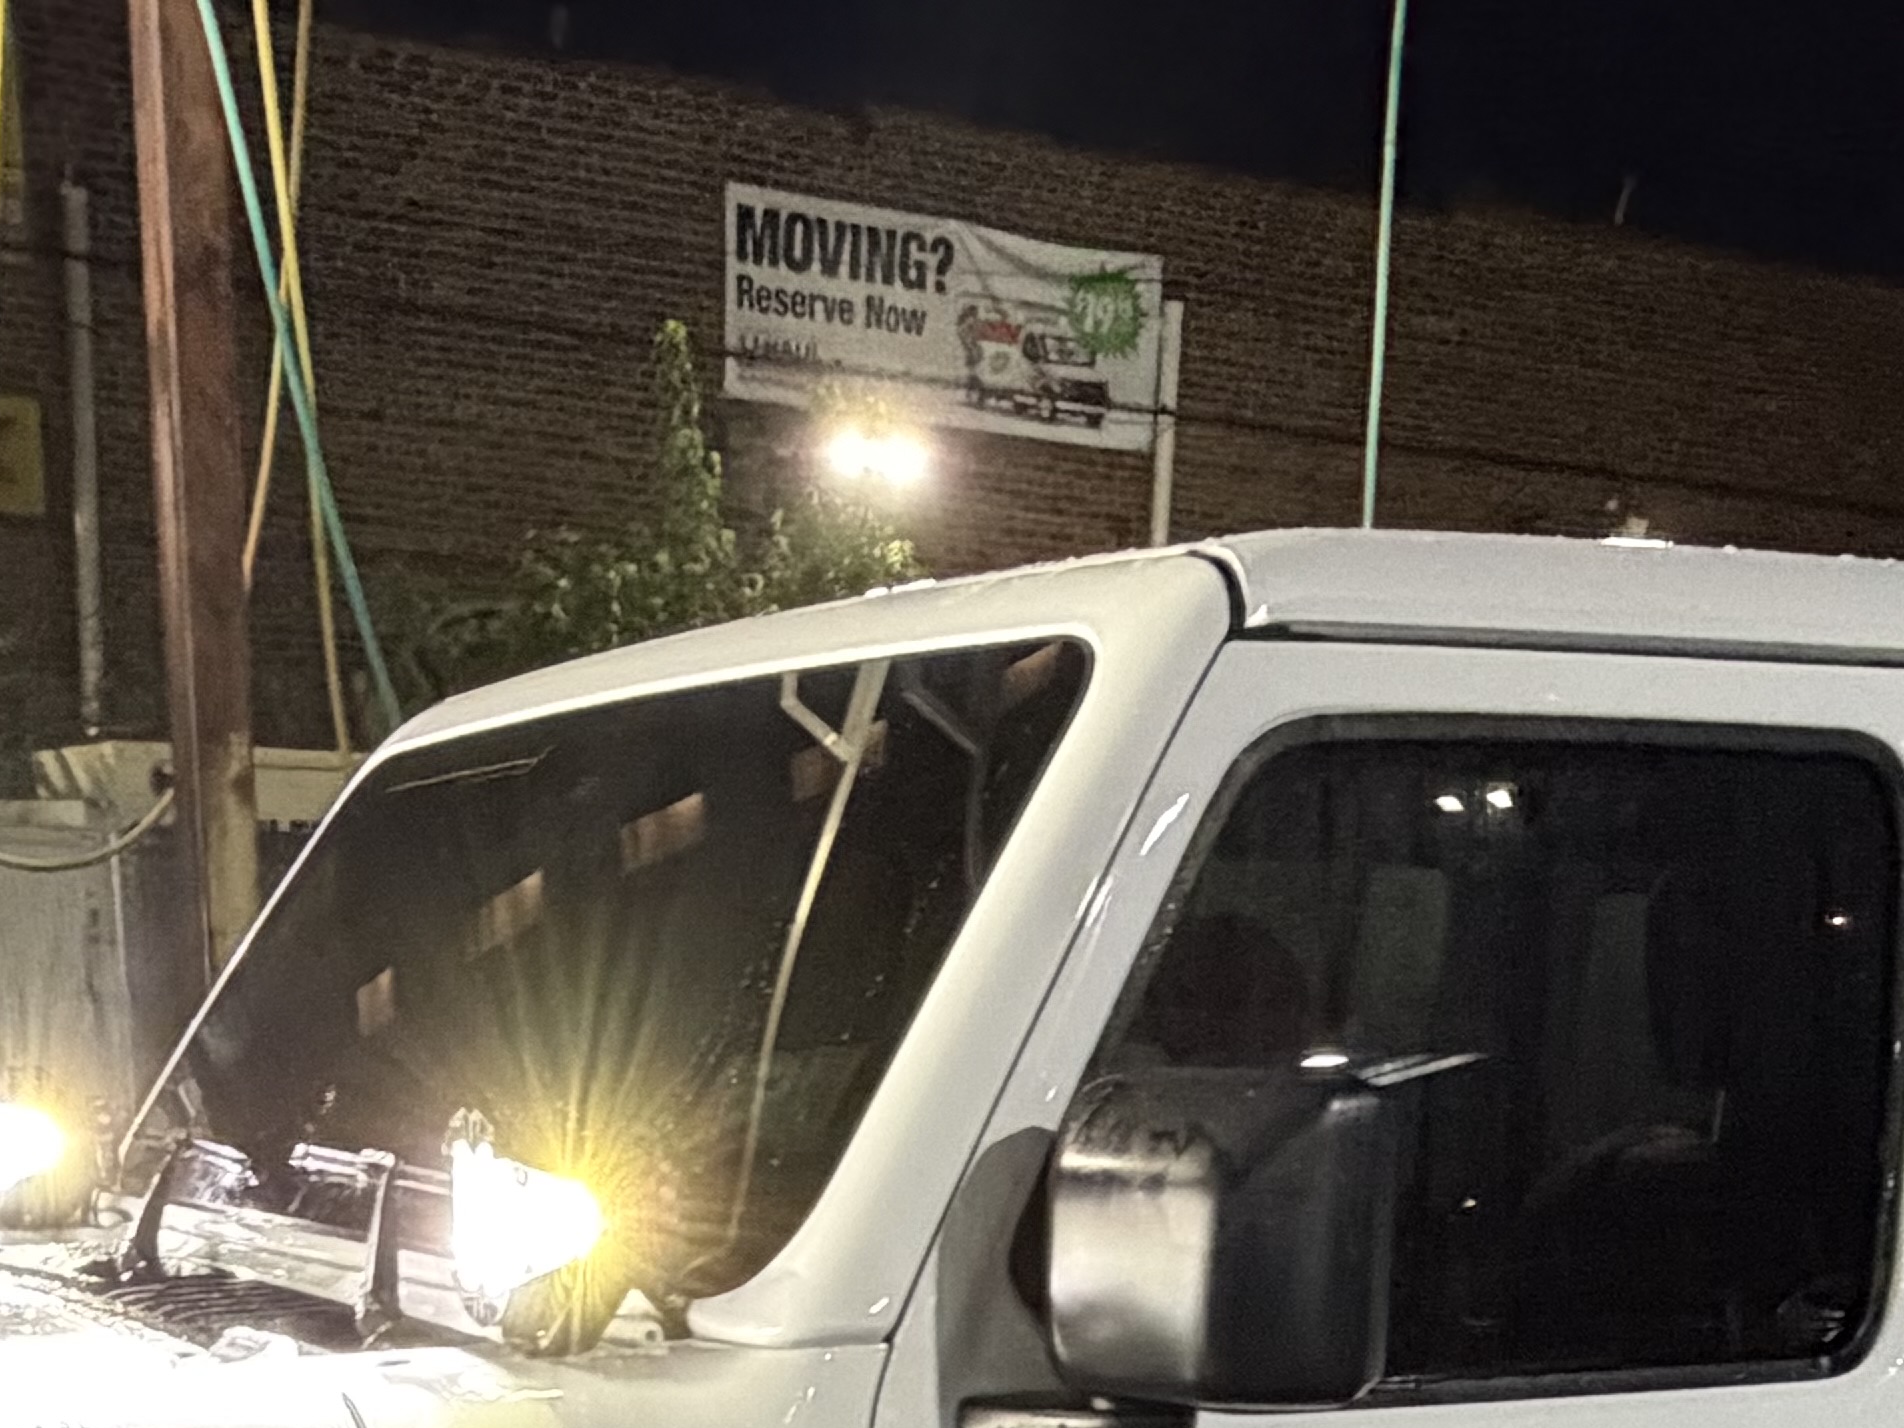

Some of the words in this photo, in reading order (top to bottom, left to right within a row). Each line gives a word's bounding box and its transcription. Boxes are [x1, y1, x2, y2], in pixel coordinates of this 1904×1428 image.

[736, 203, 956, 295] MOVING?
[736, 274, 854, 326] Reserve
[864, 296, 927, 337] Now
